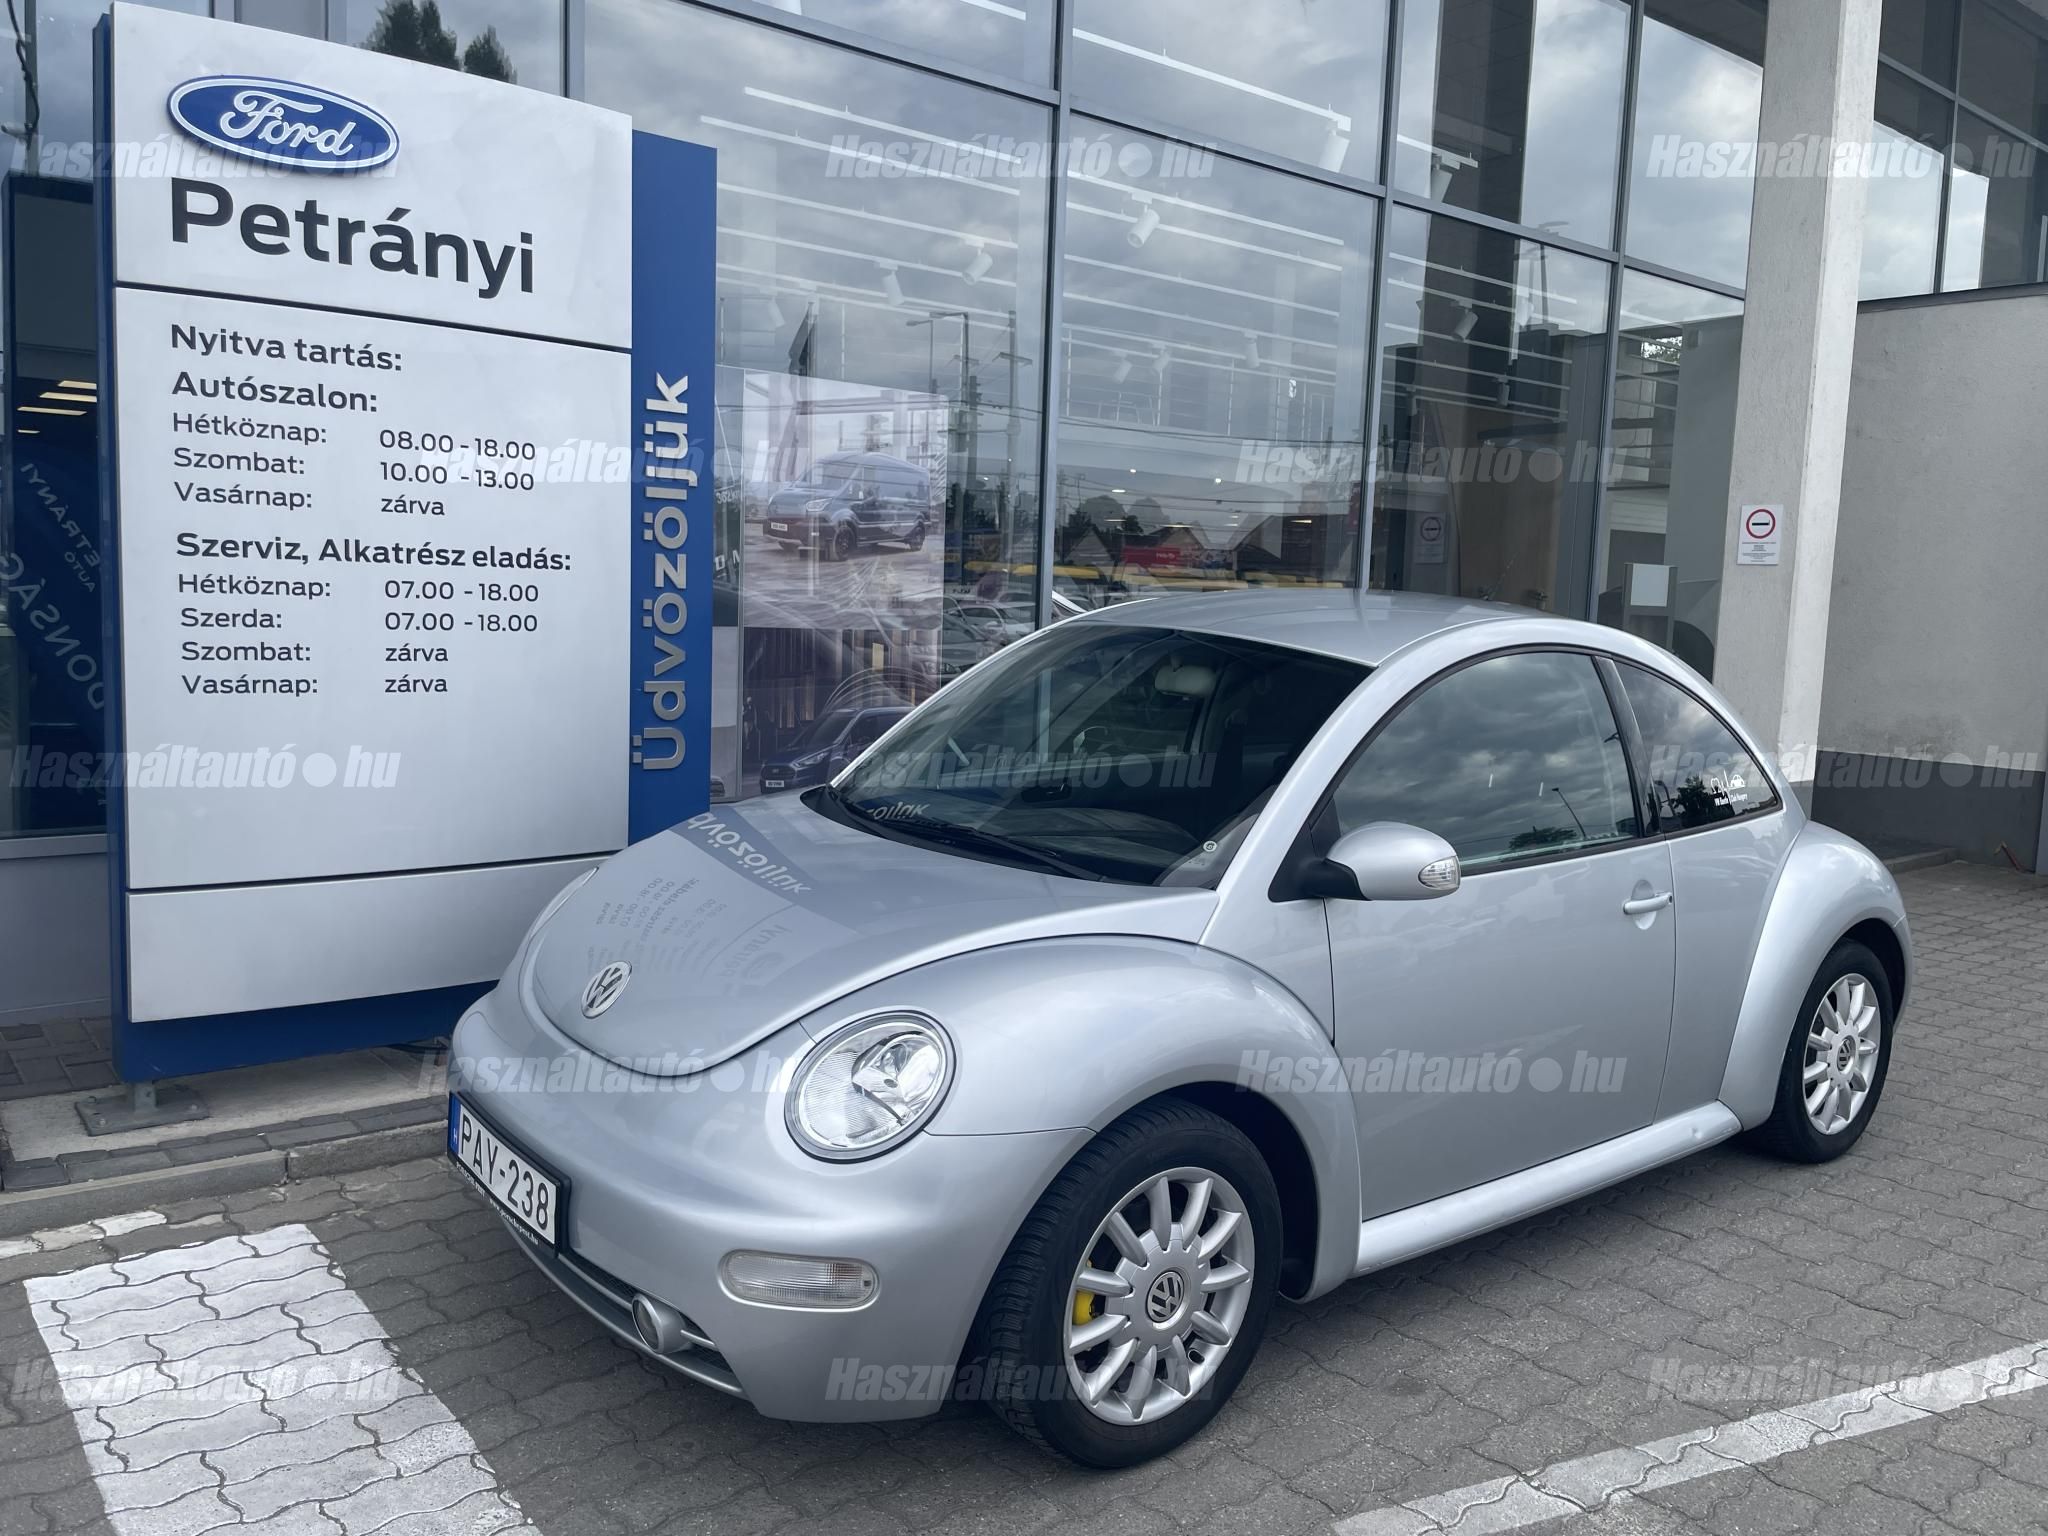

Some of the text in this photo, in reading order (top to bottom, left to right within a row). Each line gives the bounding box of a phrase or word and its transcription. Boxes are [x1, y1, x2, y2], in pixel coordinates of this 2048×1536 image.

[219, 90, 357, 156] Ford
[171, 176, 535, 300] Petrányi
[171, 323, 402, 371] Nyitva tartás:
[171, 370, 378, 413] Autószalon:
[173, 412, 327, 446] Hétköznap:
[379, 429, 454, 453] 08.00
[474, 437, 536, 461] 18.00
[173, 447, 305, 475] Szombat:
[380, 461, 448, 485] 10.00
[475, 469, 534, 491] 13.00
[173, 481, 445, 516] Vasárnap: zárva
[176, 532, 571, 571] Szerviz, Alkatrész eladás:
[631, 371, 698, 771] Üdvözöljük
[178, 573, 331, 600] Hétköznap:
[384, 580, 454, 600] 07.00
[478, 583, 539, 602] 18.00
[180, 607, 282, 629] Szerda:
[385, 612, 455, 631] 07.00
[477, 614, 538, 632] 18.00
[181, 641, 449, 662] Szombat: zárva
[181, 673, 448, 698] Vasárnap: zárva
[461, 1113, 549, 1231] PAY-238
